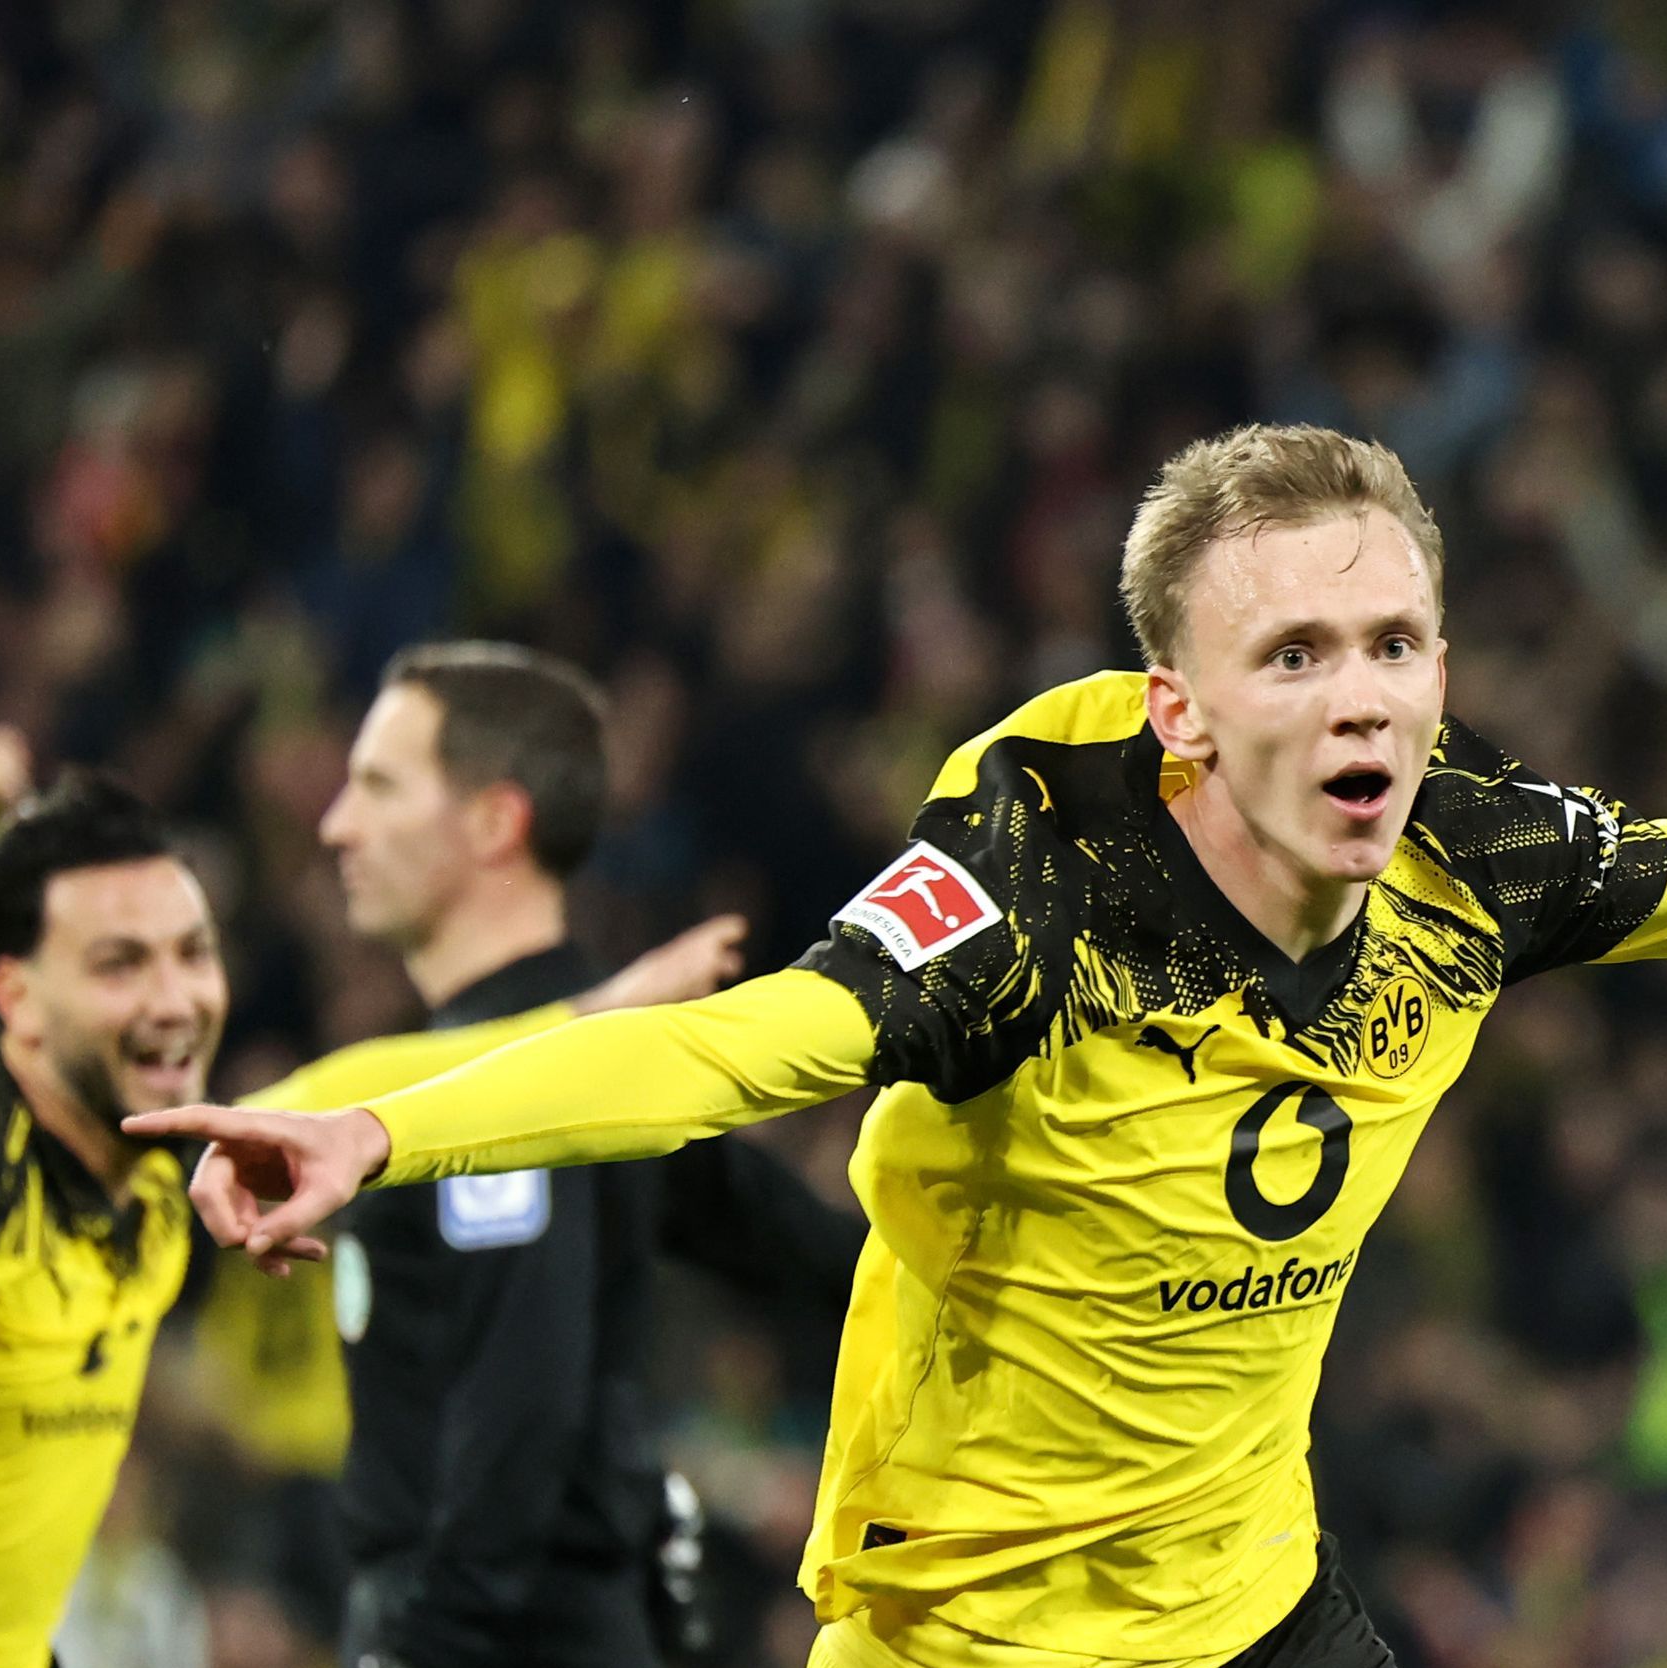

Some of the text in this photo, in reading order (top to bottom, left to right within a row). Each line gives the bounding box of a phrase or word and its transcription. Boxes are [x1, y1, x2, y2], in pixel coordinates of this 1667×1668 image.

[1370, 984, 1424, 1060] BVB
[1388, 1043, 1410, 1070] 09
[1159, 1248, 1355, 1313] vodafone
